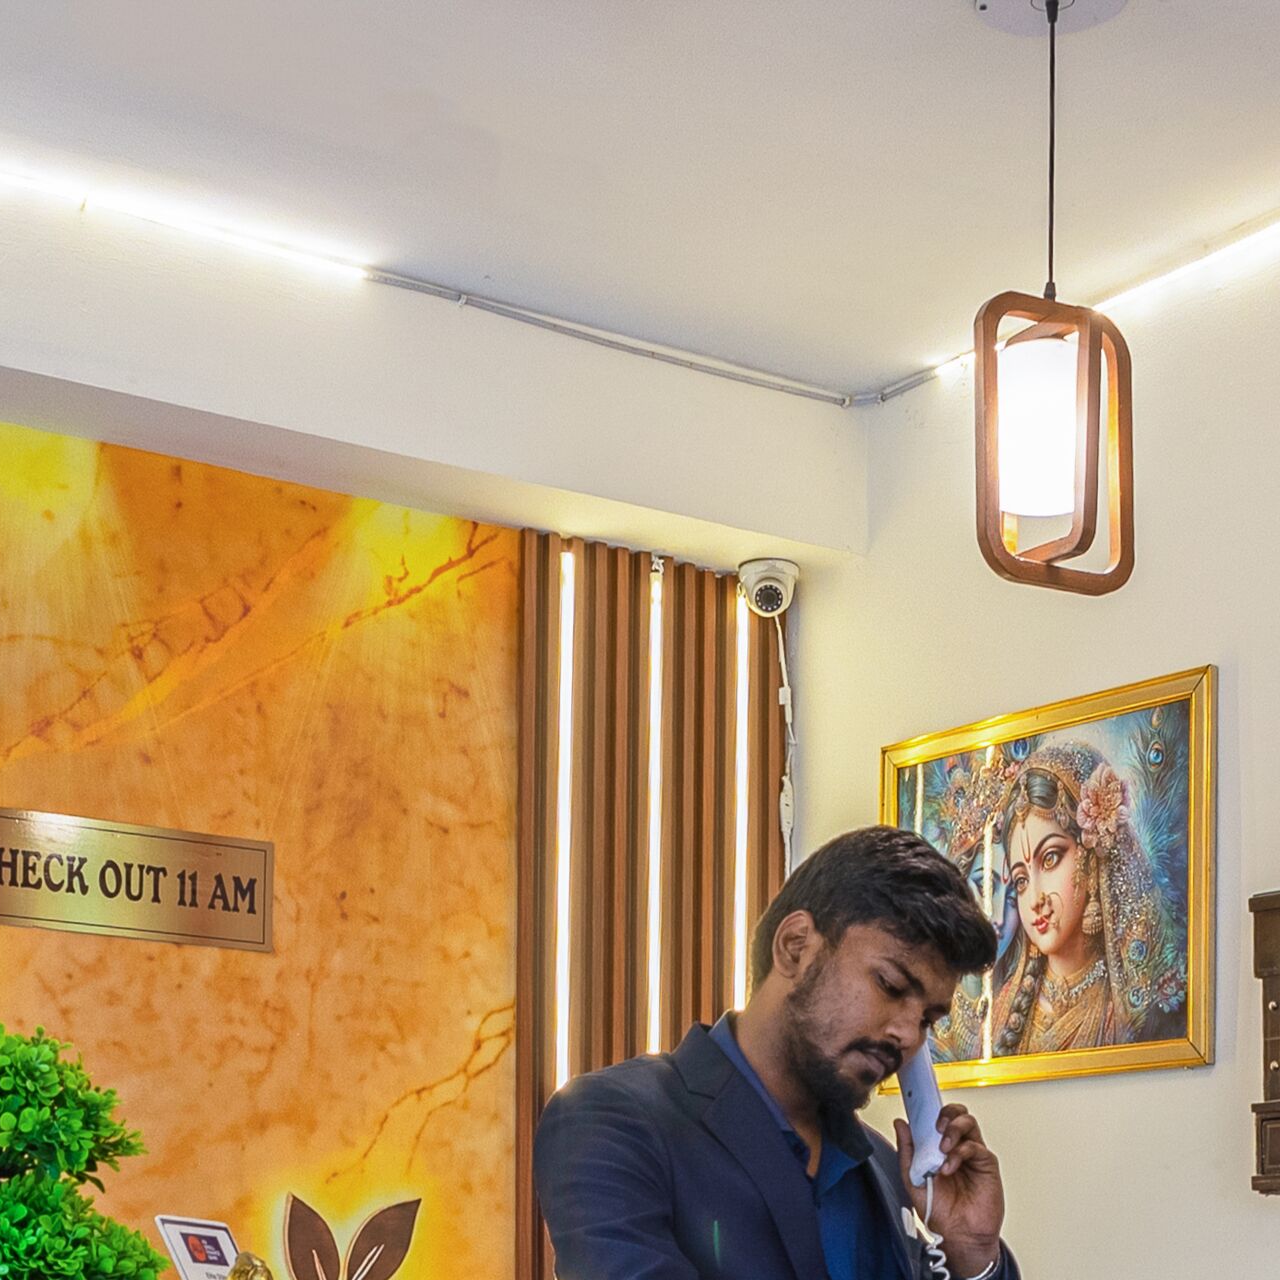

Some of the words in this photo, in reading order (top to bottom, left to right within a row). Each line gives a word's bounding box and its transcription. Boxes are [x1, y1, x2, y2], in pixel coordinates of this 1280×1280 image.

[99, 859, 167, 904] OUT
[176, 869, 198, 908] 11
[208, 873, 257, 915] AM
